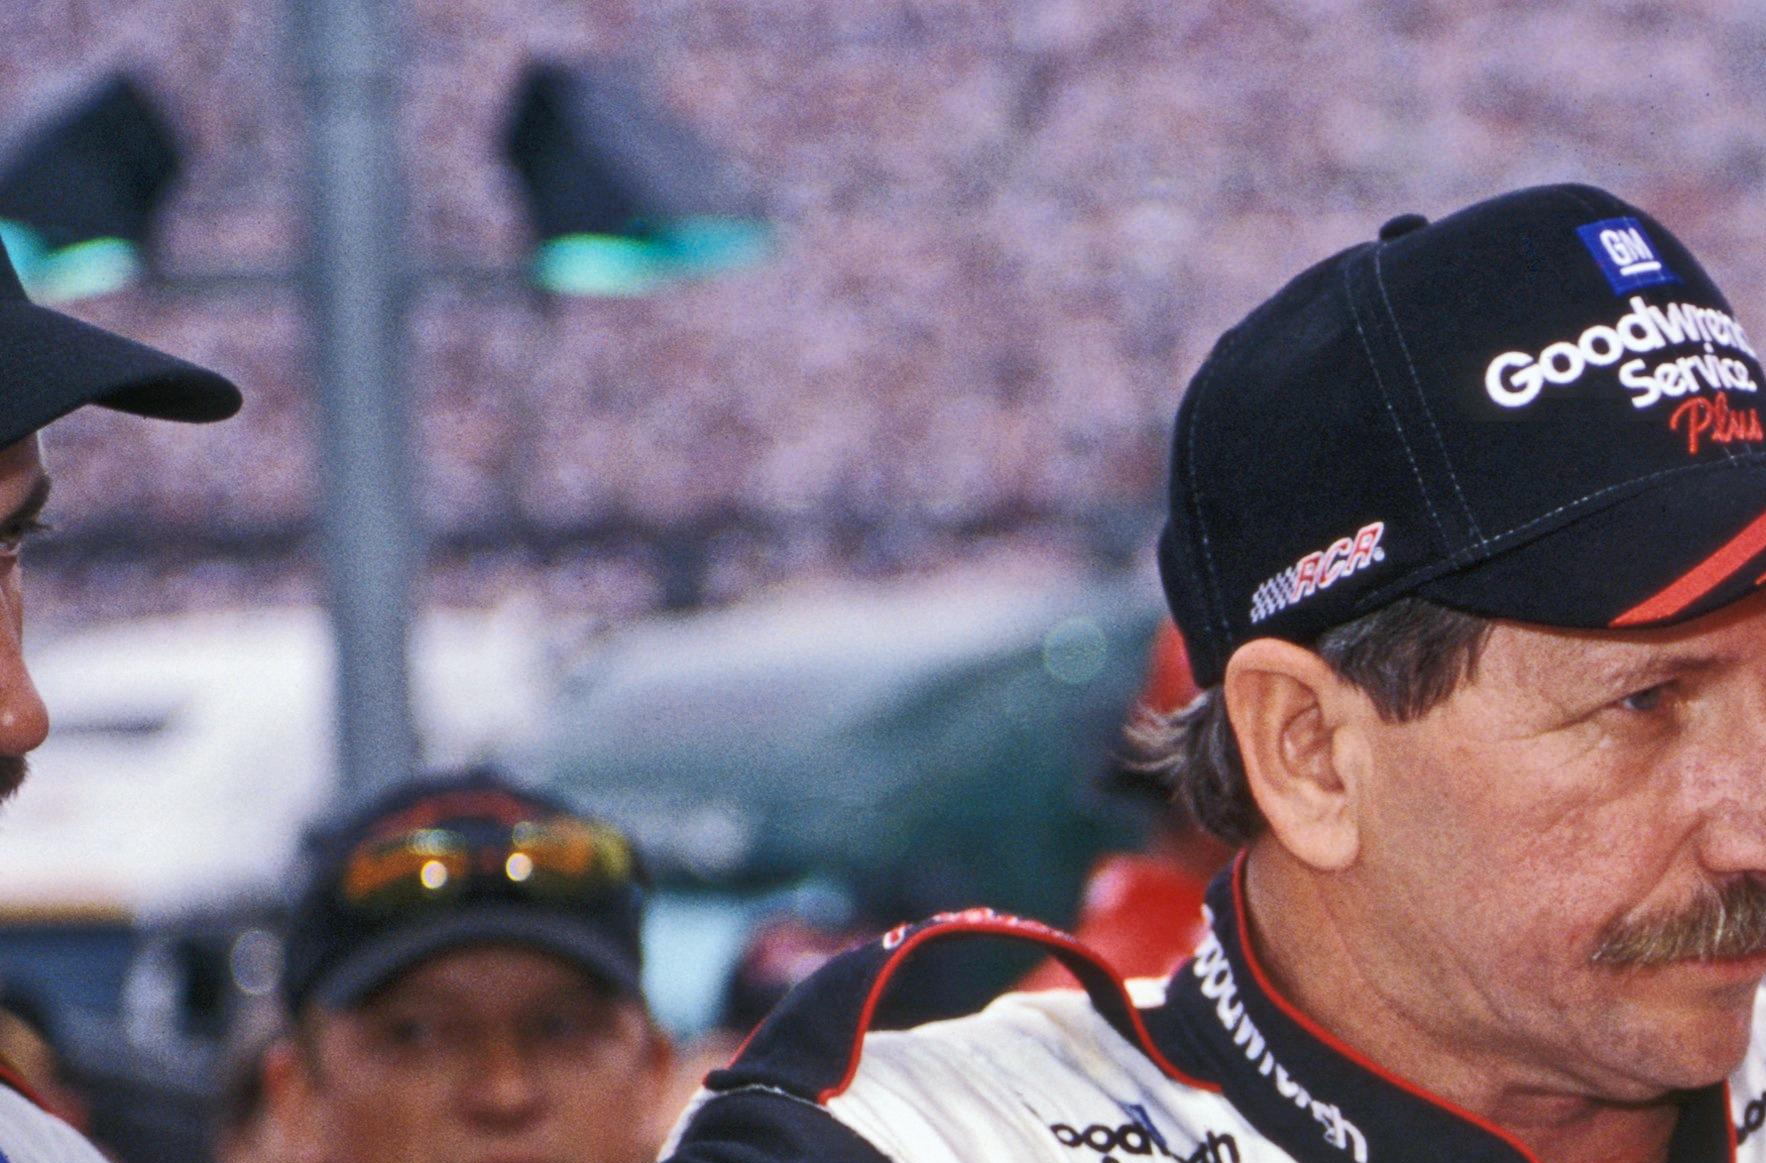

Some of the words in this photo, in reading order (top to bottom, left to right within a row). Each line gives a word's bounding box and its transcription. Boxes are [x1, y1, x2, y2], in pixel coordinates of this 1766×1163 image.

[1600, 228, 1654, 266] GM
[1485, 296, 1757, 408] Goodwren
[1619, 342, 1758, 408] Service
[1669, 391, 1765, 456] Plus
